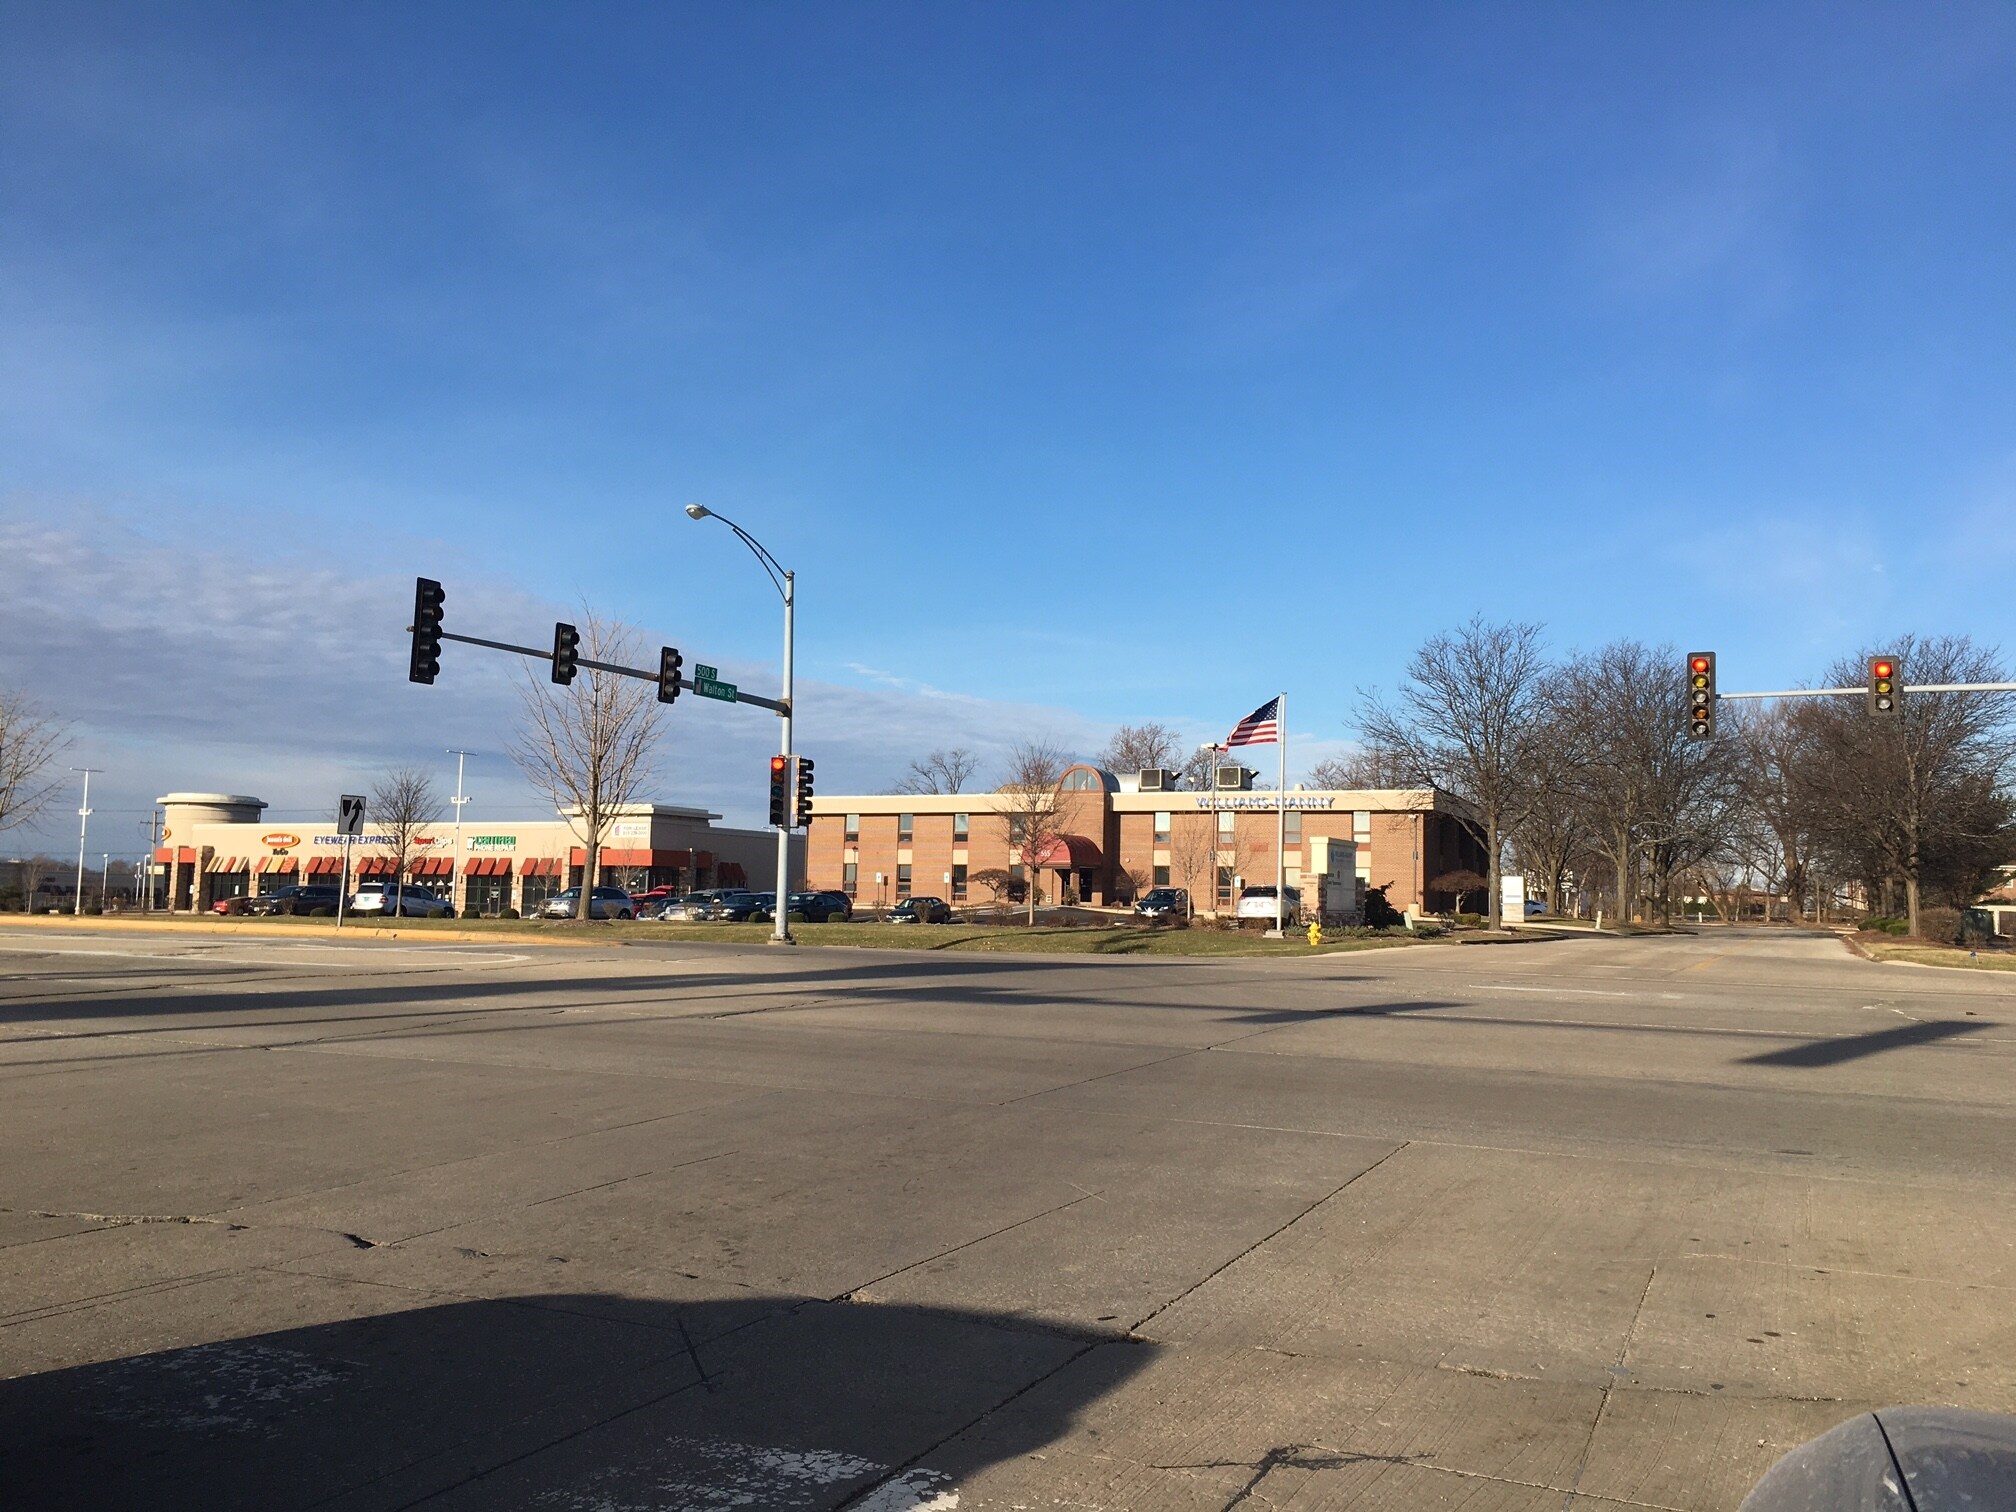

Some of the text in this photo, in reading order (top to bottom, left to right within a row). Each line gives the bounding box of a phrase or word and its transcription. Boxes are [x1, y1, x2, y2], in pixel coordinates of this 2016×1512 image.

[697, 666, 716, 679] 500 S
[704, 683, 735, 698] Walton St
